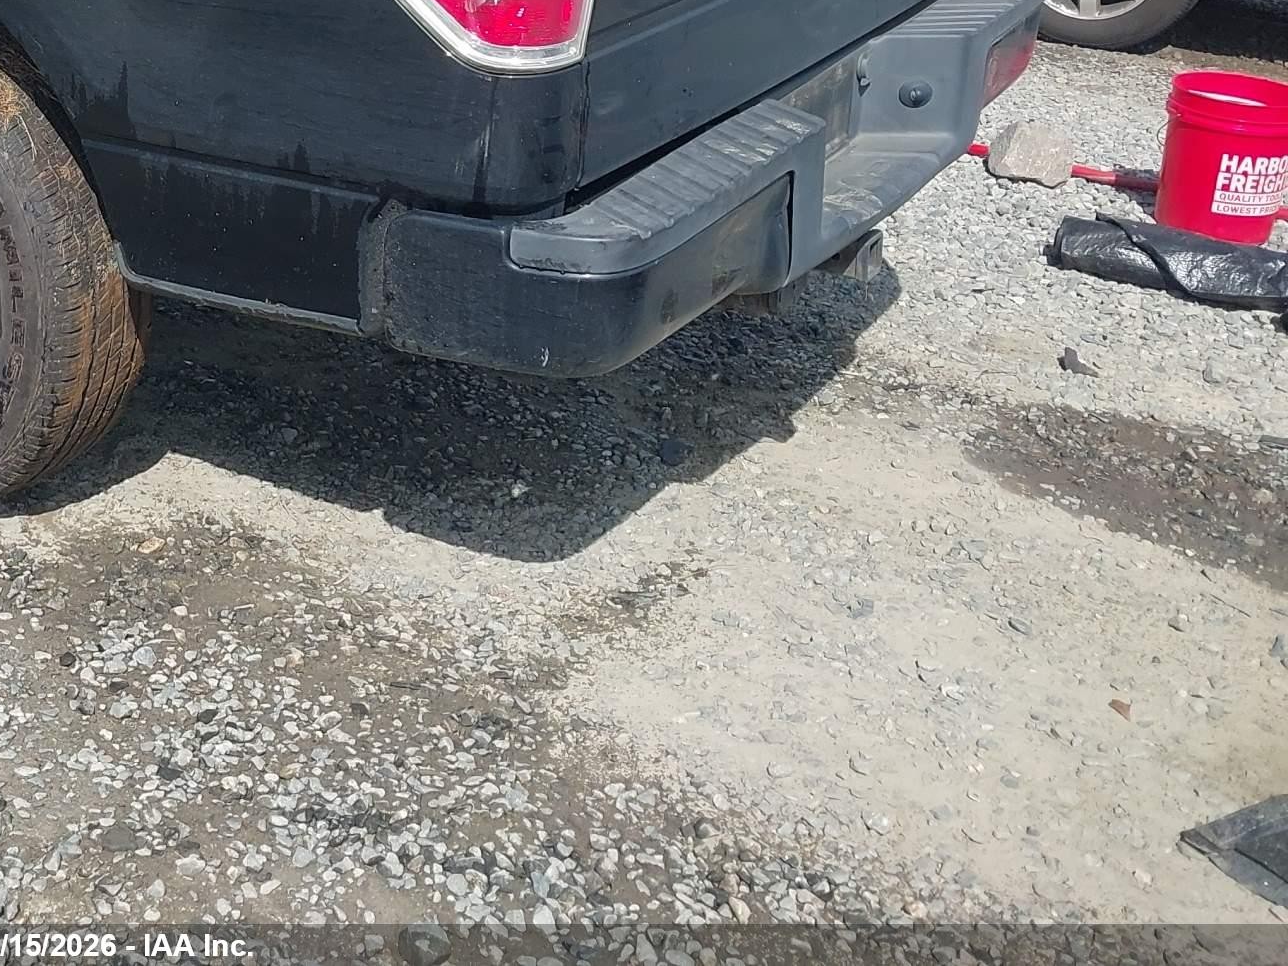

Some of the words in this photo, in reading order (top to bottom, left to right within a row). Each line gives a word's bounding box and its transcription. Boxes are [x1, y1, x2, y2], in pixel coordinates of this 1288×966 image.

[1219, 153, 1288, 175] HARBO
[1219, 193, 1264, 203] QUALITY
[1216, 204, 1259, 214] LOWEST
